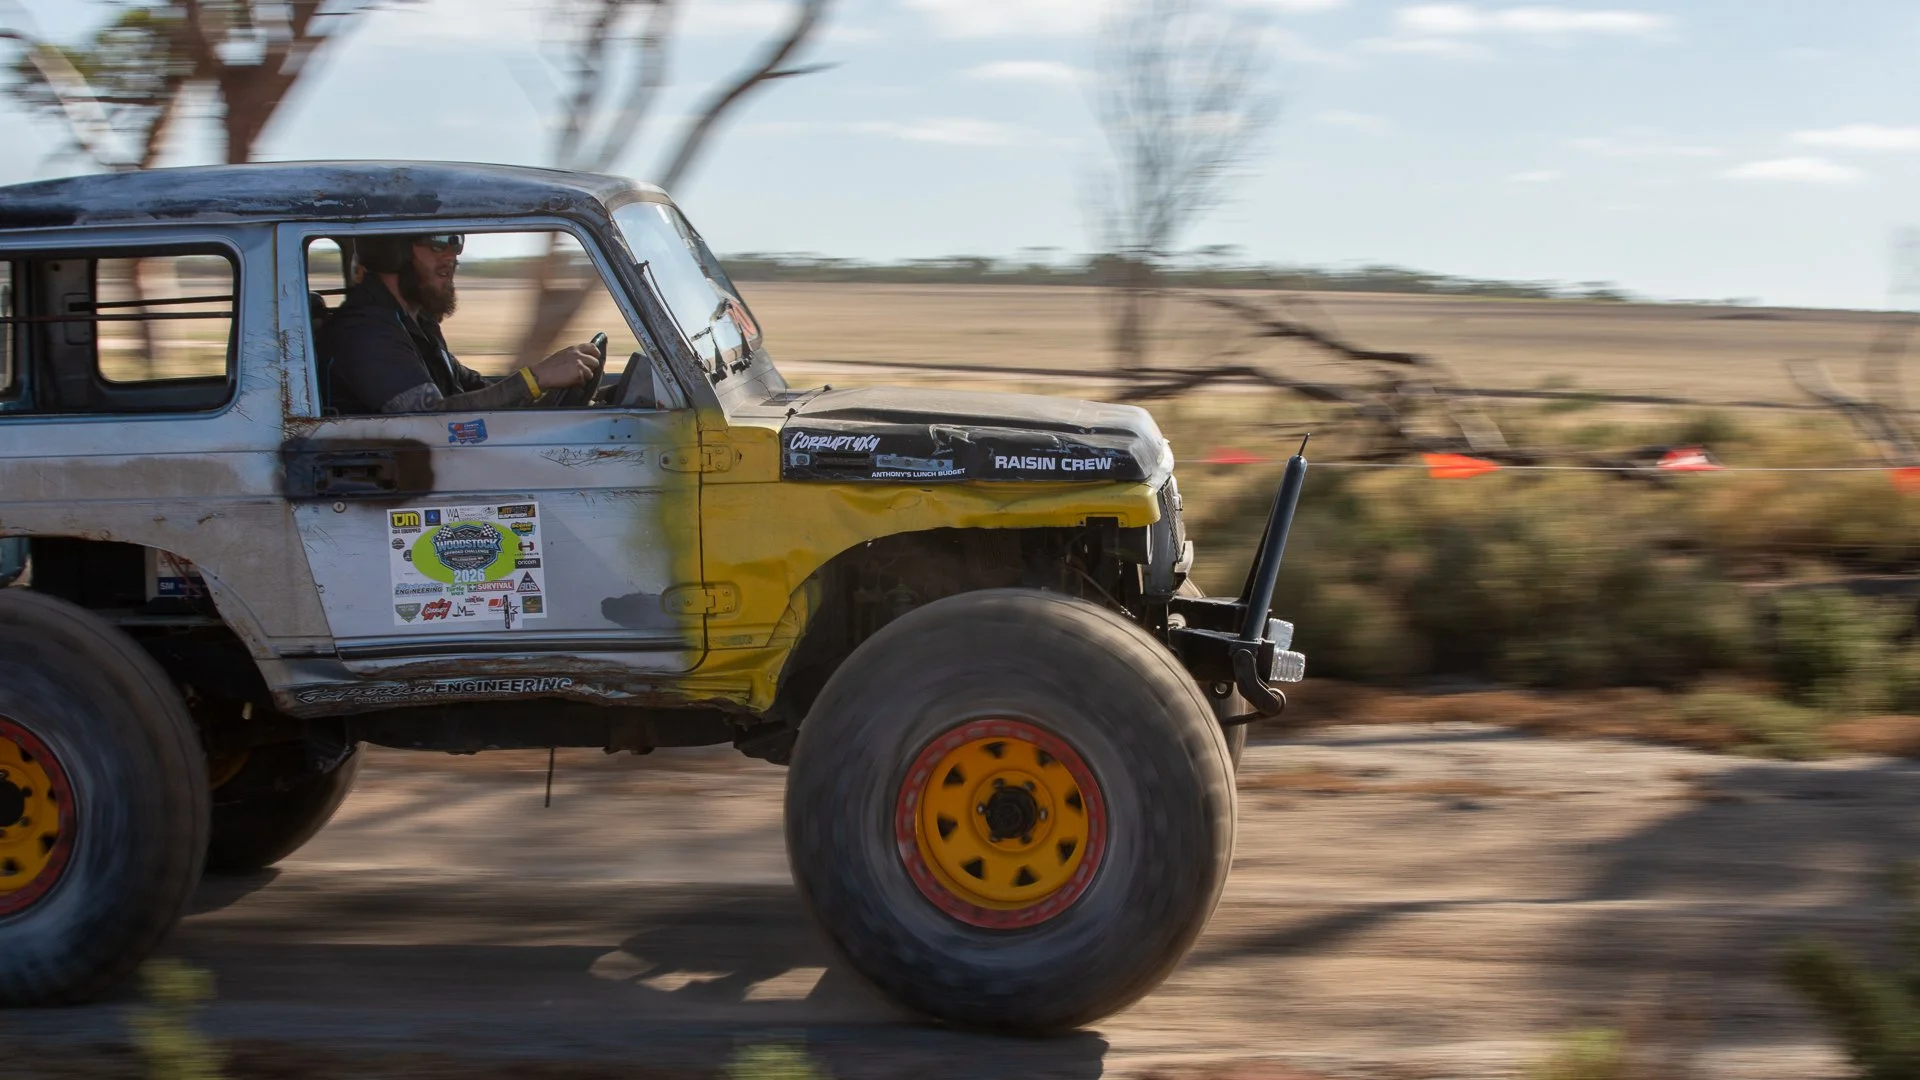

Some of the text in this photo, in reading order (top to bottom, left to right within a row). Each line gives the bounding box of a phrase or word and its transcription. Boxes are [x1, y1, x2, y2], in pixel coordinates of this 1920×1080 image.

[995, 455, 1112, 471] RAISIN CREW
[938, 468, 966, 477] BUDGET
[436, 539, 499, 552] WOODSTOCK
[454, 568, 485, 583] 2026
[395, 587, 443, 595] ENGINEERING
[477, 581, 513, 590] SURVIVAL
[434, 677, 573, 694] ENGINEERING
